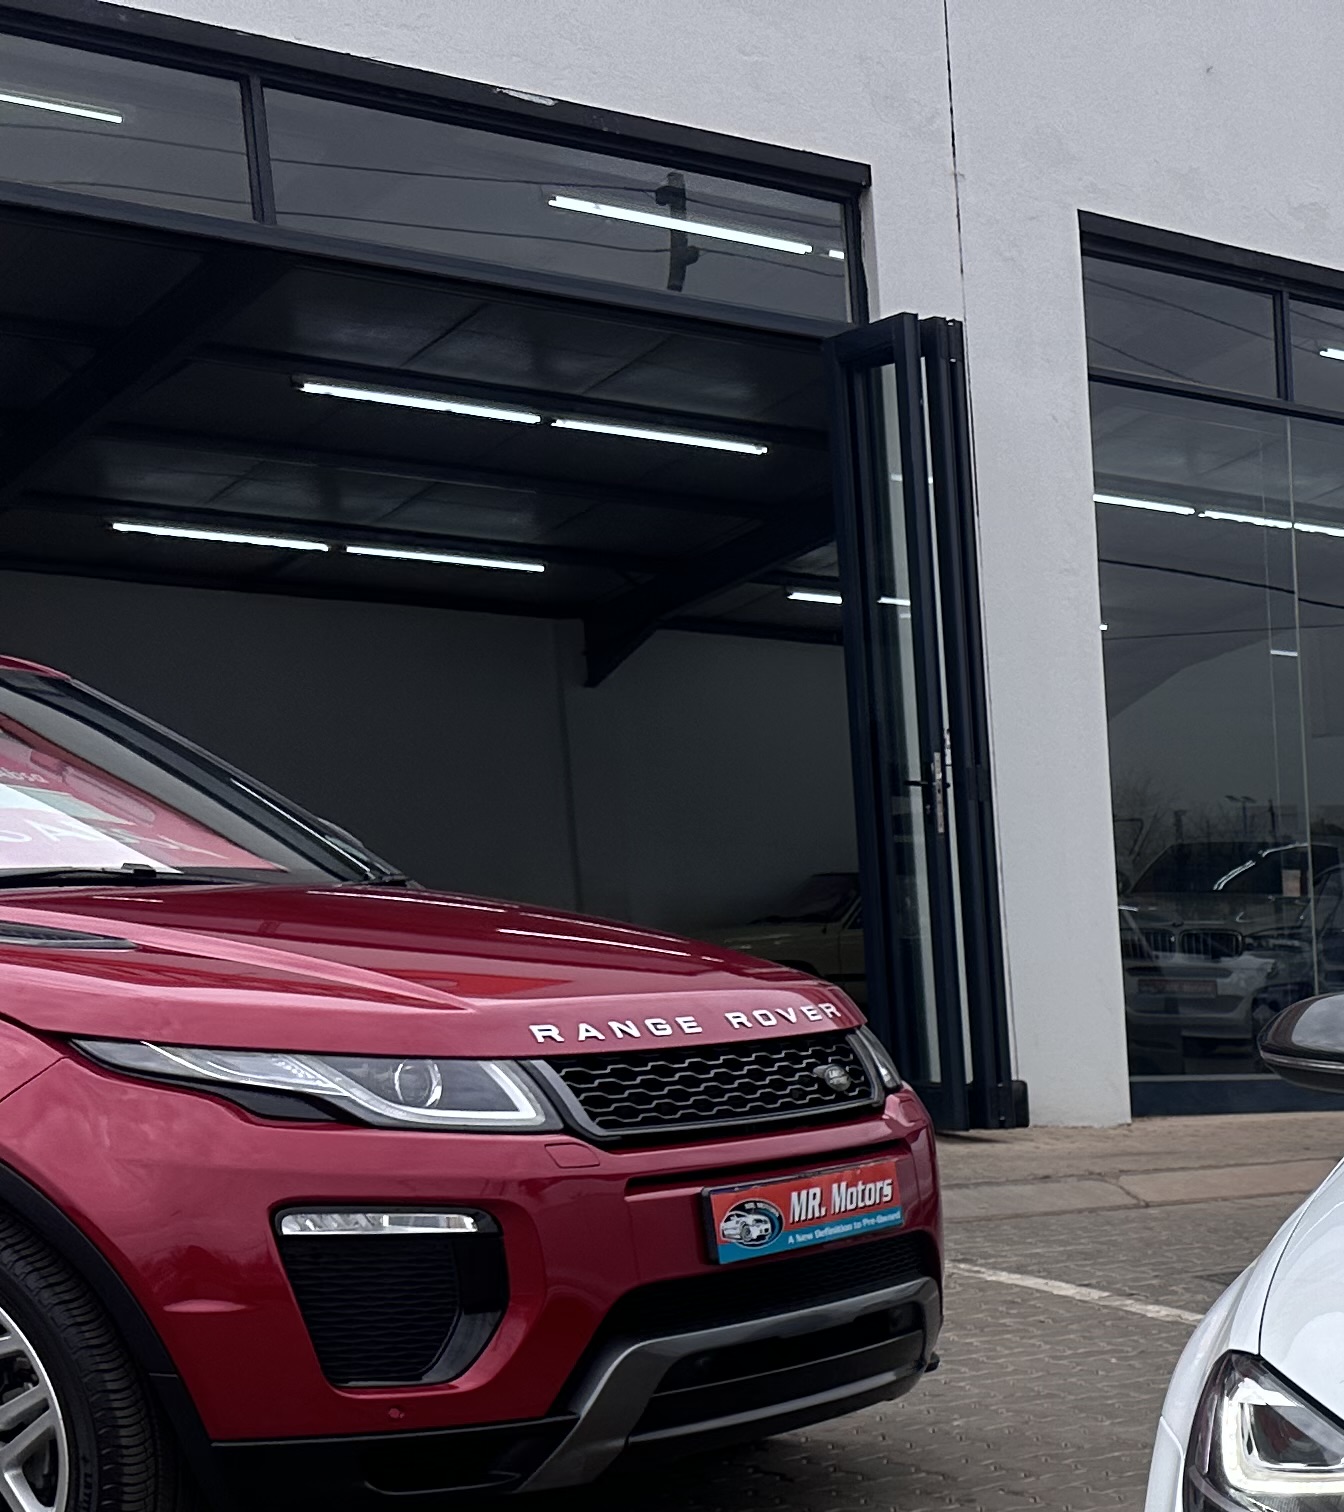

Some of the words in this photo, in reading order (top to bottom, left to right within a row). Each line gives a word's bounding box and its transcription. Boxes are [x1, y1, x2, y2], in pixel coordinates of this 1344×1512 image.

[529, 1015, 703, 1044] RANGE
[724, 1002, 842, 1030] ROVER
[789, 1186, 828, 1225] MR.
[830, 1178, 894, 1216] Motors
